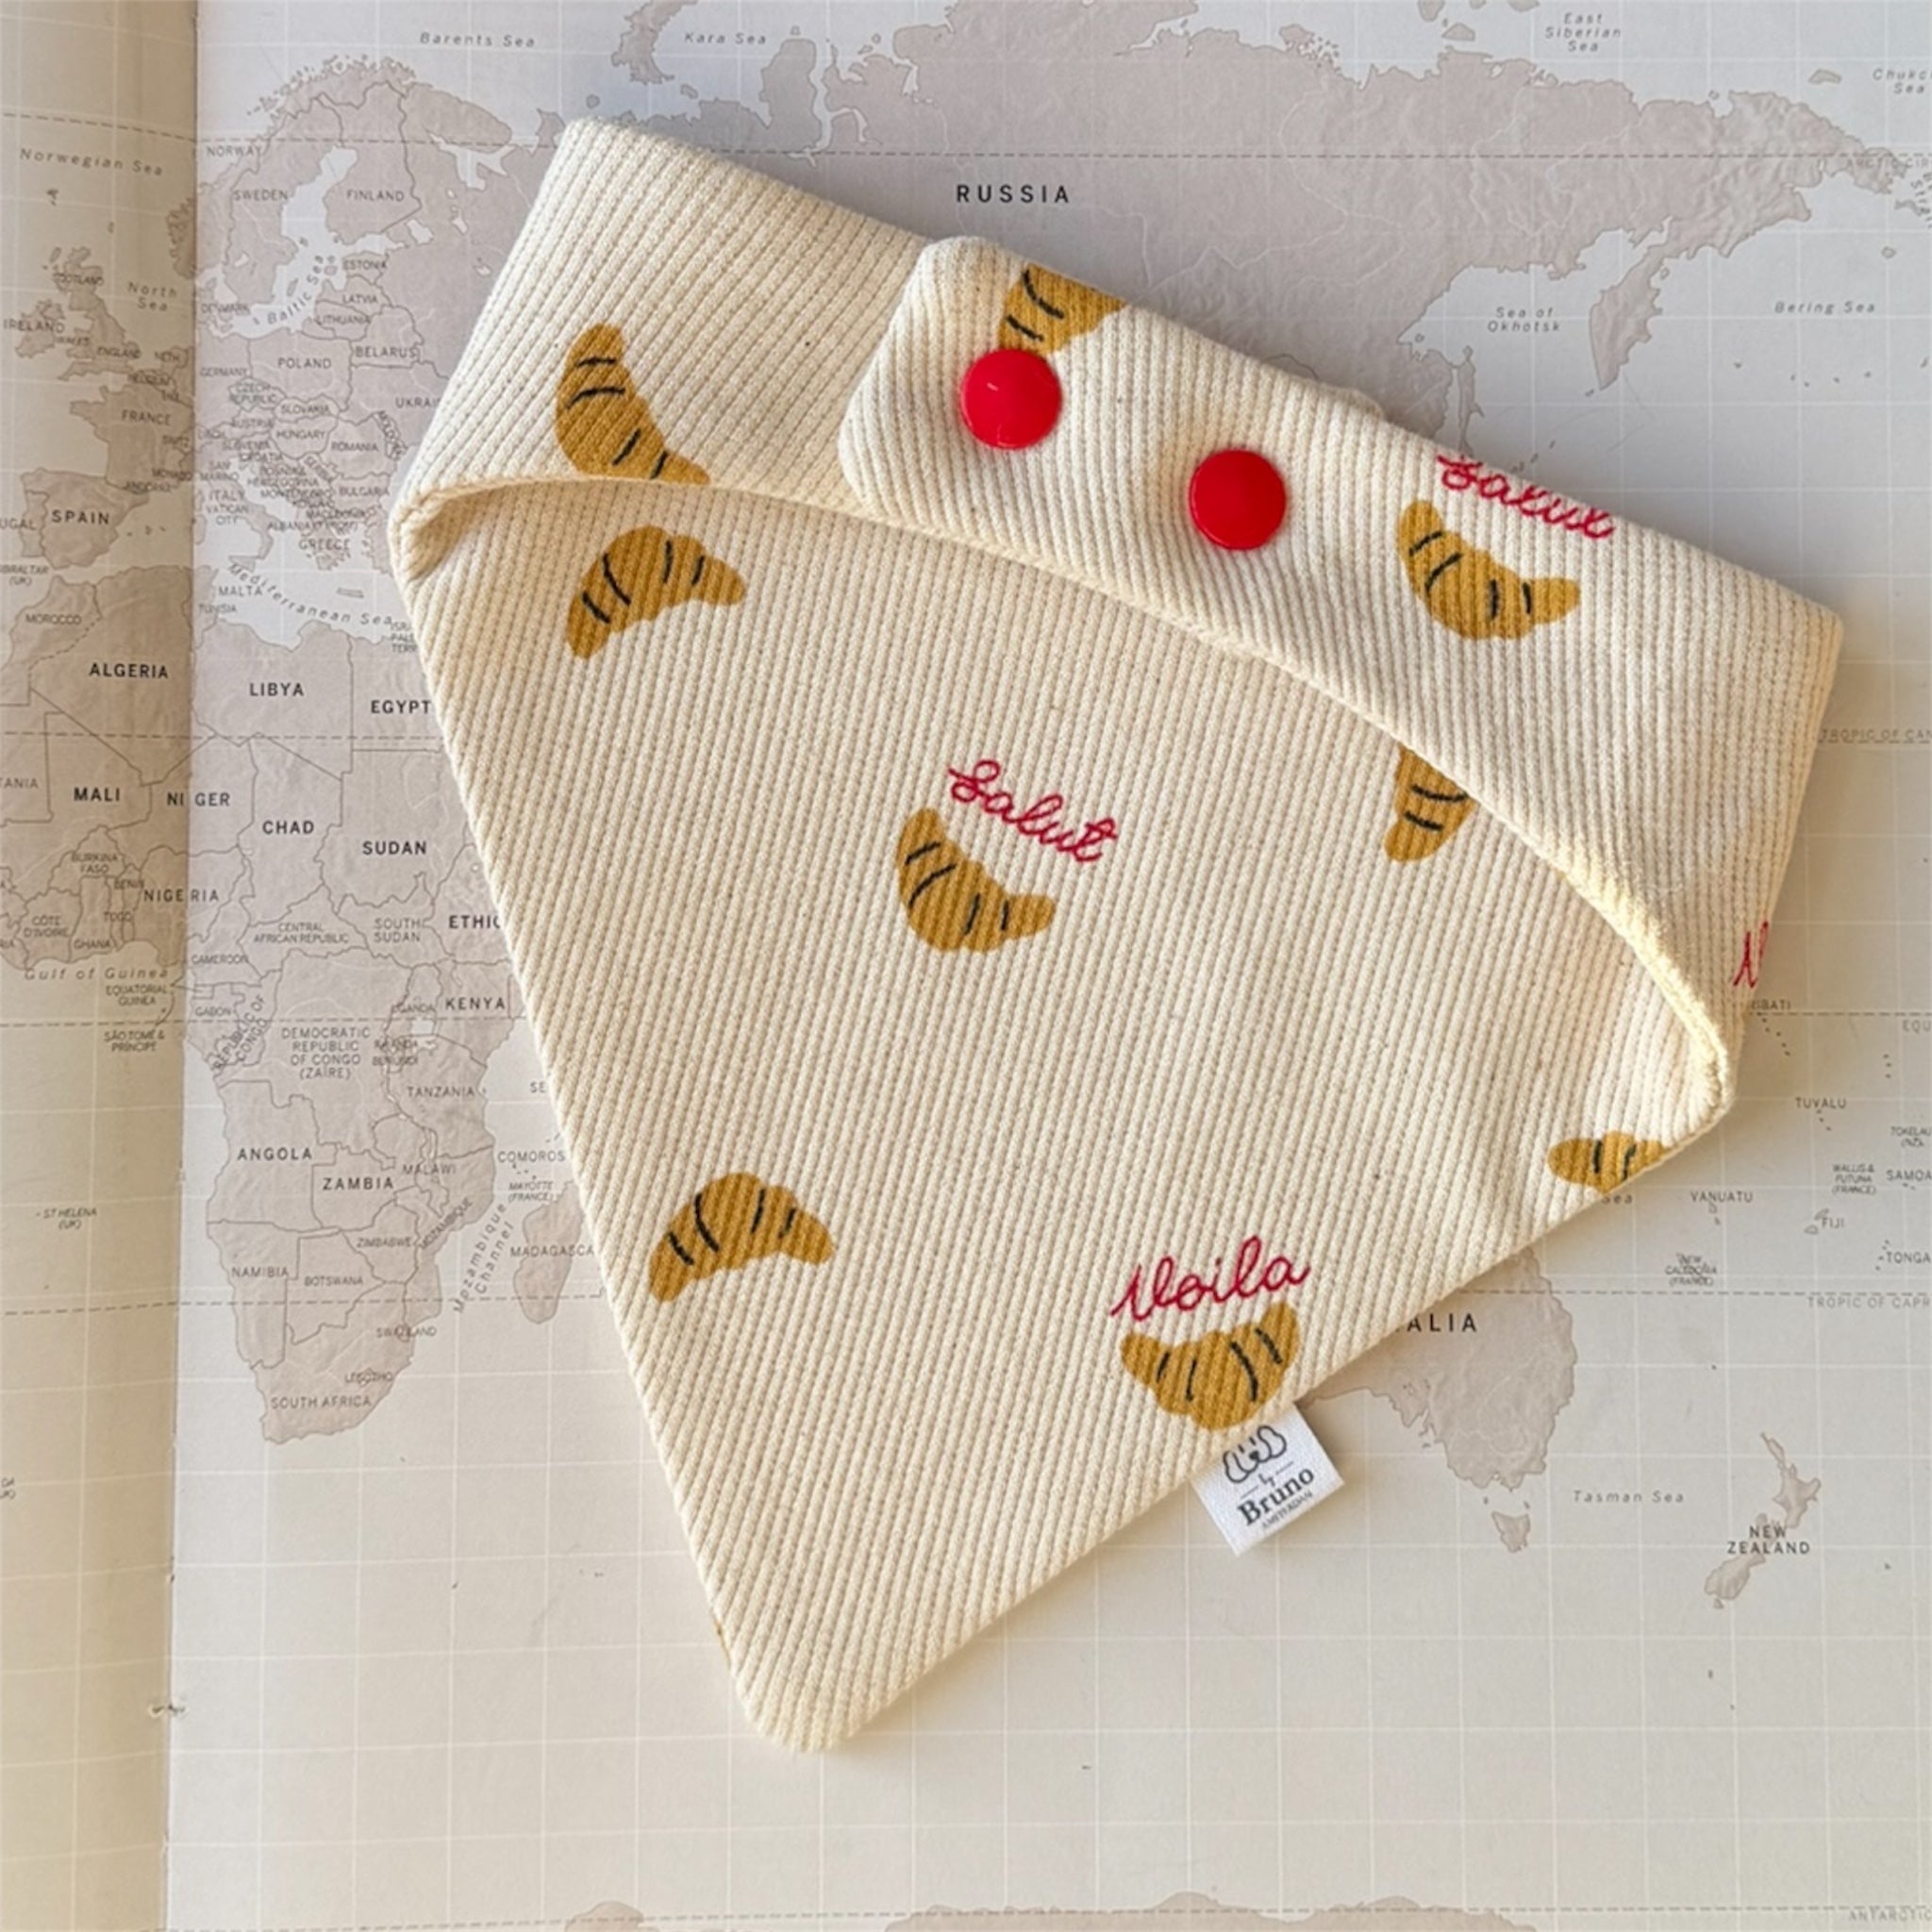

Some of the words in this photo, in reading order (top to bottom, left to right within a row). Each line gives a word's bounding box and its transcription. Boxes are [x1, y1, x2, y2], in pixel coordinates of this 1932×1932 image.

[1564, 12, 1603, 25] East
[685, 32, 725, 44] Kara
[736, 33, 766, 45] Sea
[1545, 26, 1622, 39] Siberian
[420, 32, 492, 46] Barents
[504, 35, 535, 47] Sea
[1568, 41, 1598, 52] Sea
[1873, 67, 1932, 81] Chukc
[1894, 82, 1924, 94] Sea
[206, 145, 262, 158] NORWAY
[20, 147, 124, 170] Norwegian
[132, 159, 164, 176] Sea
[234, 190, 289, 201] SWEDEN
[347, 190, 405, 202] FINLAND
[956, 184, 1069, 204] RUSSIA
[342, 259, 388, 270] ESTONIA
[127, 282, 177, 297] North
[267, 291, 311, 325] Baltic
[307, 255, 324, 286] Sea
[138, 297, 168, 311] Sea
[342, 294, 378, 304] LATVIA
[1495, 307, 1526, 319] Sea
[1536, 307, 1554, 319] of
[1774, 301, 1835, 316] Bering
[1843, 300, 1875, 313] Sea
[3, 318, 65, 334] IRELAND
[1488, 321, 1560, 333] Okhotsk
[355, 346, 417, 358] BELARUS
[277, 358, 331, 369] POLAND
[121, 409, 172, 425] FRANCE
[276, 430, 325, 440] HUNGARY
[208, 490, 244, 501] ITALY
[51, 509, 110, 525] SPAIN
[298, 539, 351, 551] GREECE
[218, 585, 262, 596] MALTA
[228, 562, 352, 623] Mediterranean
[360, 613, 392, 625] Sea
[25, 614, 82, 625] MOROCCO
[89, 662, 169, 679] ALGERIA
[249, 683, 305, 697] LIBYA
[371, 700, 431, 714] EGYPT
[1881, 728, 1898, 741] OF
[74, 787, 121, 802] MALI
[167, 792, 230, 808] NIGER
[948, 758, 1119, 863] Salut
[263, 821, 314, 835] CHAD
[363, 841, 426, 856] SUDAN
[143, 890, 219, 903] NIGERIA
[278, 923, 324, 932] CENTRAL
[375, 918, 421, 929] SOUTH
[254, 934, 298, 943] AFRICAN
[375, 932, 421, 942] SUDAN
[192, 955, 248, 964] CAMEROON
[25, 968, 66, 980] Gulf
[75, 968, 94, 980] of
[104, 967, 168, 979] Guinea
[251, 994, 266, 1012] OF
[445, 997, 506, 1010] KENYA
[282, 1027, 370, 1039] DEMOCRATIC
[236, 1017, 268, 1063] CONGO
[292, 1041, 359, 1053] REPUBLIC
[291, 1054, 308, 1066] OF
[311, 1054, 361, 1066] CONGO
[408, 1086, 475, 1097] TANZANIA
[1795, 1097, 1846, 1108] TUVALU
[238, 1147, 312, 1161] ANGOLA
[497, 1151, 565, 1163] COMOROS
[403, 1164, 456, 1175] MALAWI
[1886, 1170, 1932, 1181] SAMOA
[323, 1177, 394, 1191] ZAMBIA
[1690, 1191, 1753, 1203] VANUATU
[453, 1203, 507, 1313] Mozambique
[475, 1221, 514, 1294] Channel
[1886, 1252, 1931, 1263] TONGA
[231, 1267, 290, 1278] NAMIBIA
[1109, 1235, 1312, 1322] Voila
[304, 1276, 363, 1288] BOTSWANA
[1808, 1296, 1862, 1308] TROPIC
[1868, 1296, 1885, 1308] OF
[1396, 1313, 1477, 1333] ALIA
[271, 1396, 316, 1409] SOUTH
[322, 1395, 372, 1408] AFRICA
[1237, 1468, 1314, 1526] Bruno
[1573, 1490, 1642, 1503] Tasman
[1652, 1490, 1684, 1503] Sea
[1749, 1525, 1787, 1539] NEW
[1727, 1541, 1810, 1555] ZEALAND
